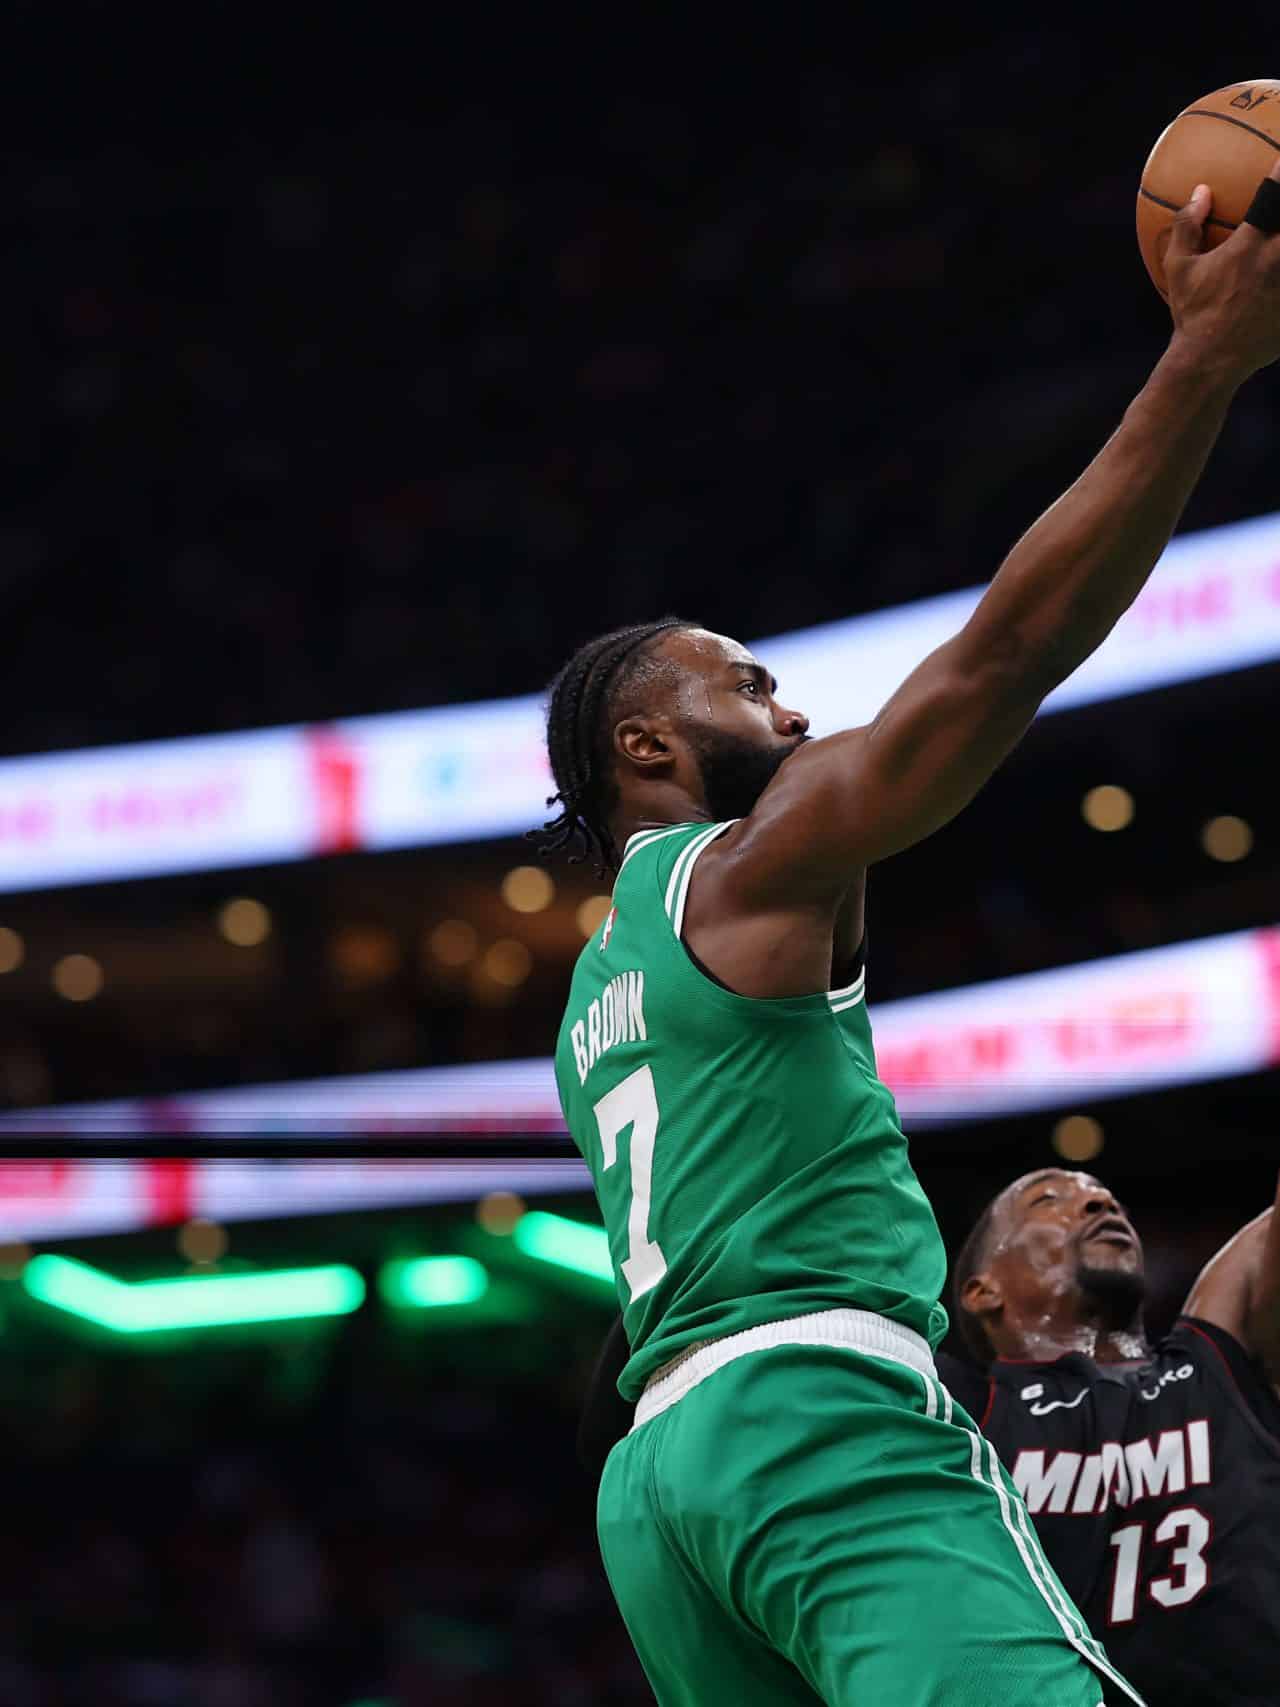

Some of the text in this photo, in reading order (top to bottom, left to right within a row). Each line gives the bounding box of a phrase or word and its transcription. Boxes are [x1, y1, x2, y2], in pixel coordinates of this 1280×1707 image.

[571, 970, 647, 1087] BROWN
[593, 1063, 668, 1304] 7
[1011, 1420, 1212, 1514] MIAMI
[1109, 1506, 1211, 1623] 13
